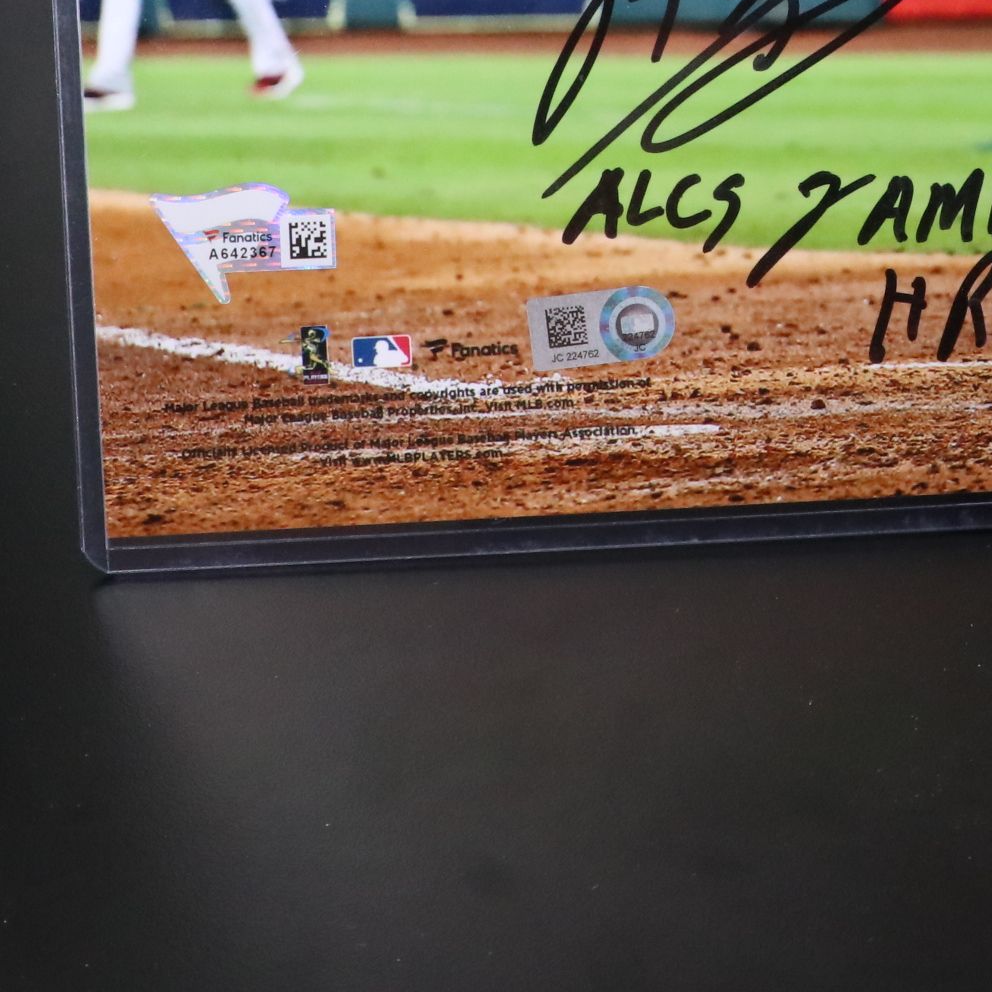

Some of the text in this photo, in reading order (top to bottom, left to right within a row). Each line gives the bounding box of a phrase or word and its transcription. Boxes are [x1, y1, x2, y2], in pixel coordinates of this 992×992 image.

[561, 166, 745, 254] ALCS
[222, 232, 273, 244] Fanatics
[209, 246, 276, 260] A642367
[451, 341, 519, 358] Fanatics
[552, 349, 600, 363] JC 224762
[634, 344, 646, 352] JC
[203, 400, 249, 412] League
[383, 391, 405, 401] and
[410, 387, 476, 402] copyrights
[480, 387, 499, 396] are
[503, 384, 533, 395] used
[536, 381, 565, 393] with
[567, 379, 634, 394] permission
[637, 377, 652, 388] of
[332, 407, 384, 420] Baseball
[486, 399, 512, 411] Visit
[300, 439, 348, 452] Product
[353, 438, 366, 448] of
[370, 437, 404, 449] Major
[408, 434, 453, 448] League
